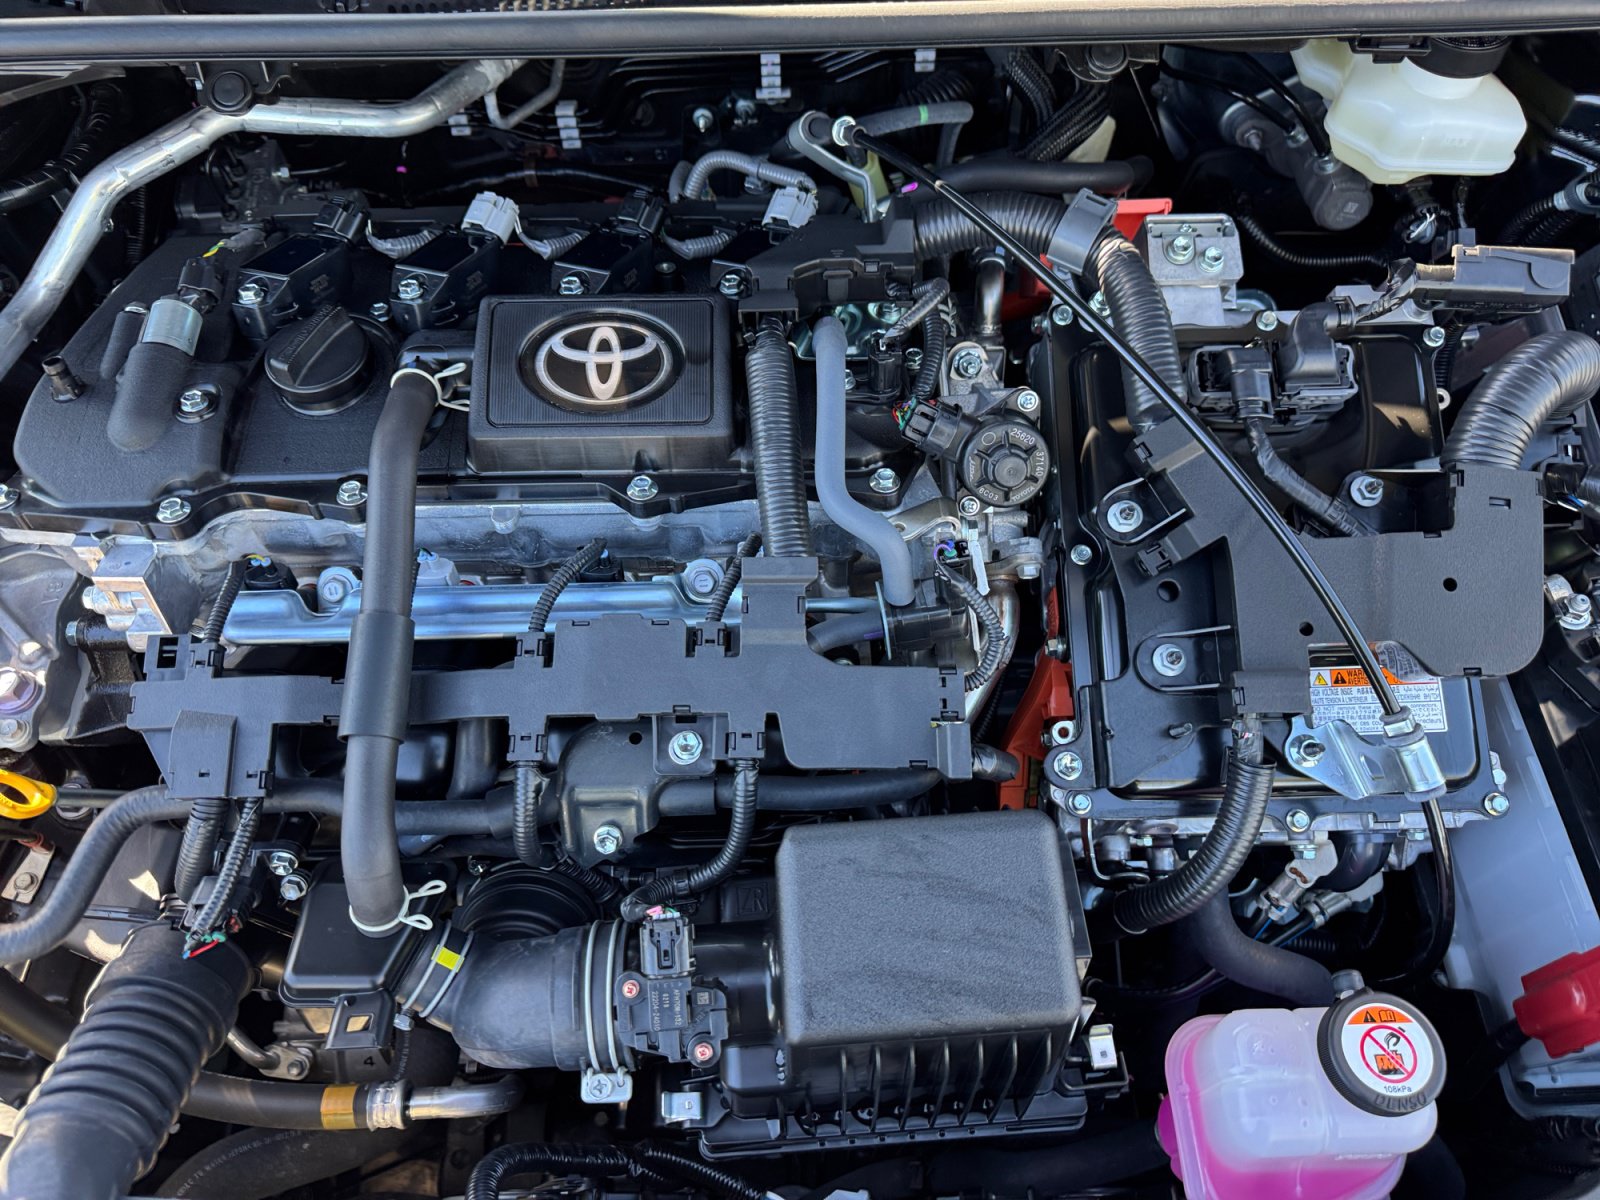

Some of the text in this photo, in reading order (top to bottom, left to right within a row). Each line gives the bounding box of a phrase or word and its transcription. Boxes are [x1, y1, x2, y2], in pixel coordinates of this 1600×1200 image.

[1010, 427, 1036, 445] 25620
[1035, 451, 1045, 477] 37140
[1011, 485, 1035, 502] TOYOTA
[1322, 688, 1339, 696] VOLTAGE
[363, 1055, 376, 1067] 4
[1383, 1085, 1413, 1094] 108kPa
[1375, 1091, 1428, 1112] DENSO
